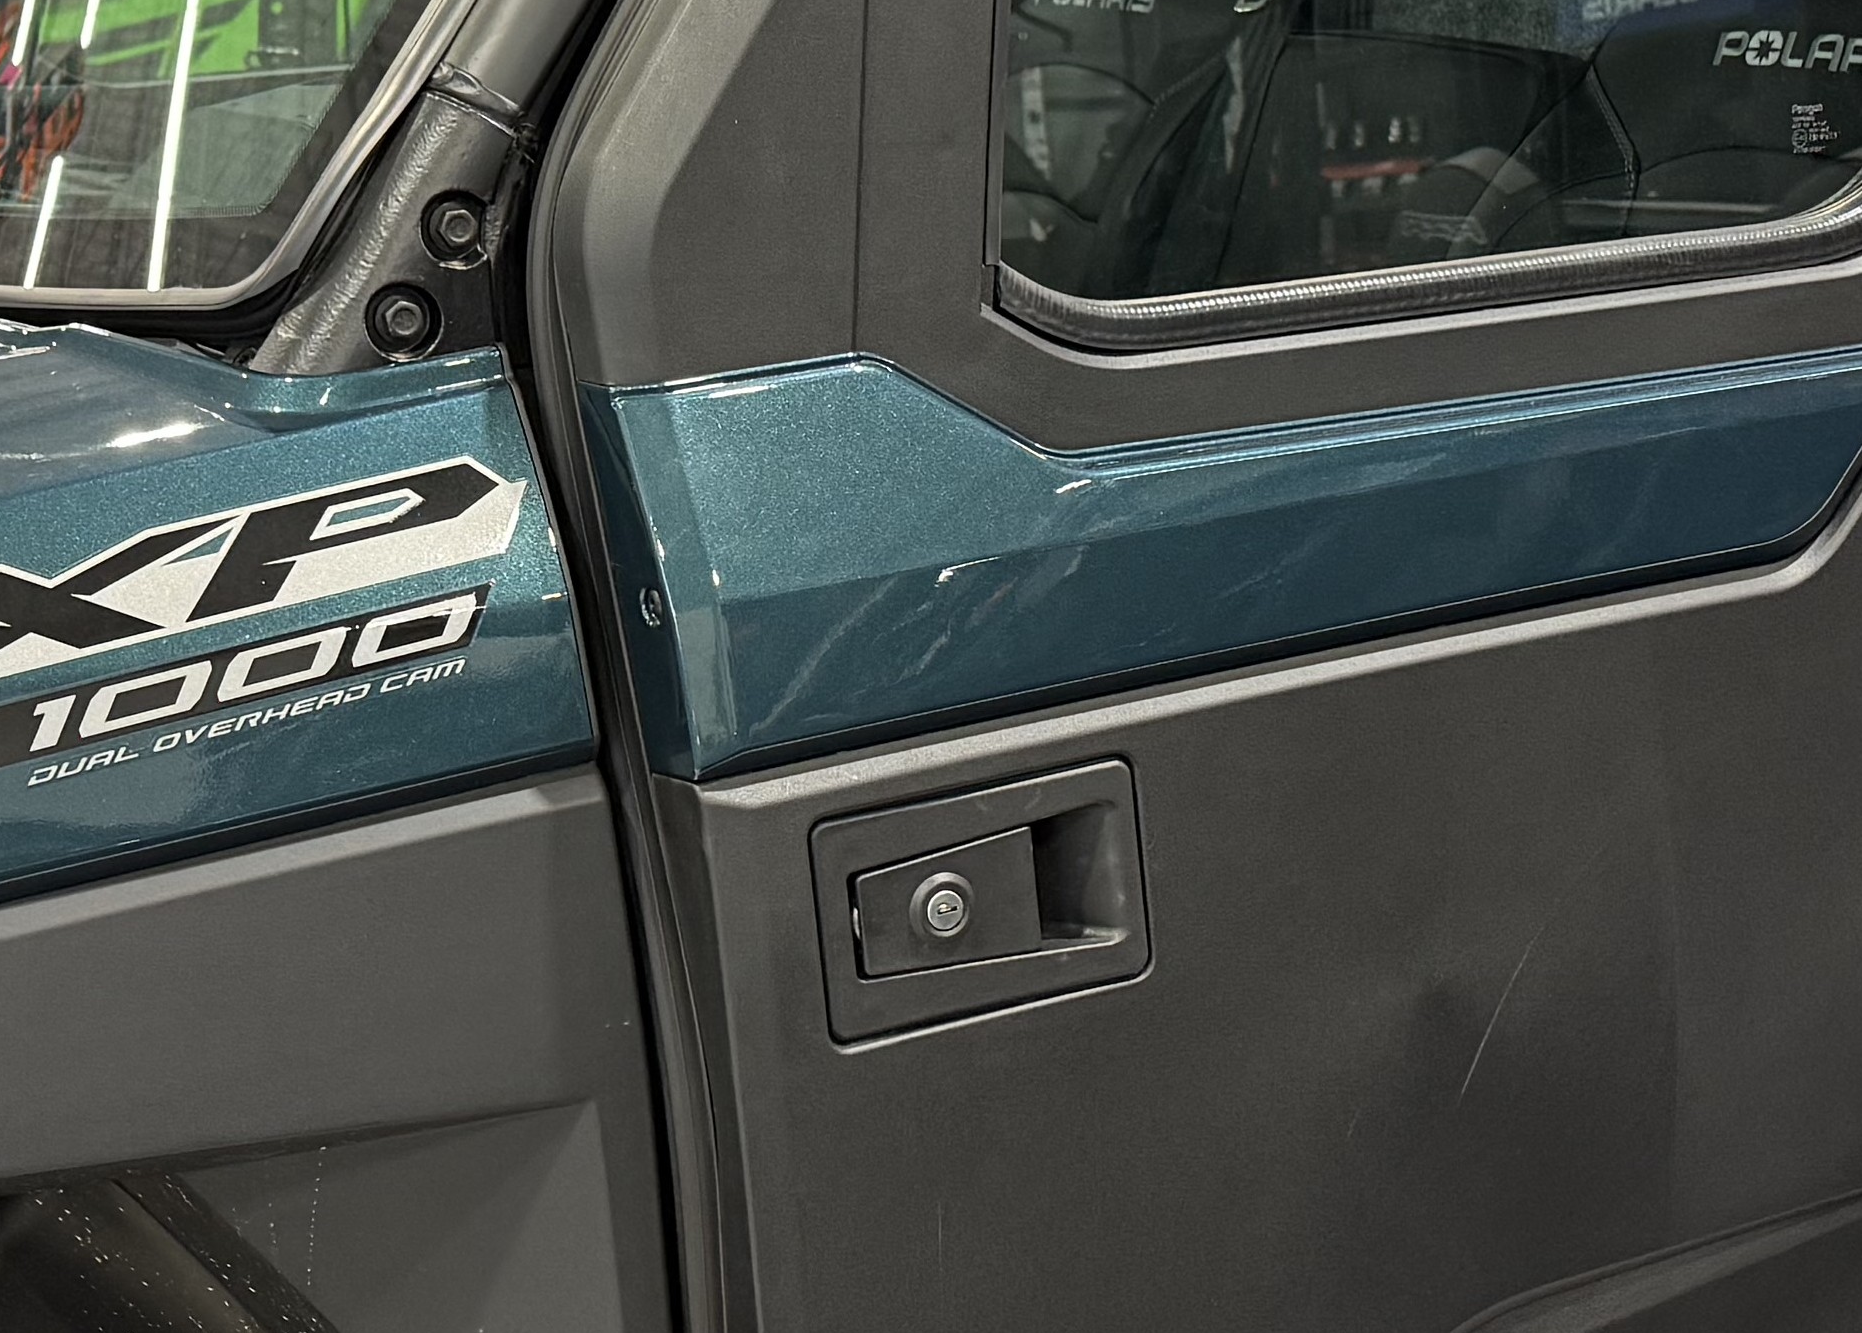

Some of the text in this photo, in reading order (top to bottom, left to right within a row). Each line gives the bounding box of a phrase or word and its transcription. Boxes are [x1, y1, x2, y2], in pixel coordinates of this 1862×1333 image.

[27, 657, 468, 788] DUAL OVERHEAD CAM
[28, 590, 479, 755] 1000
